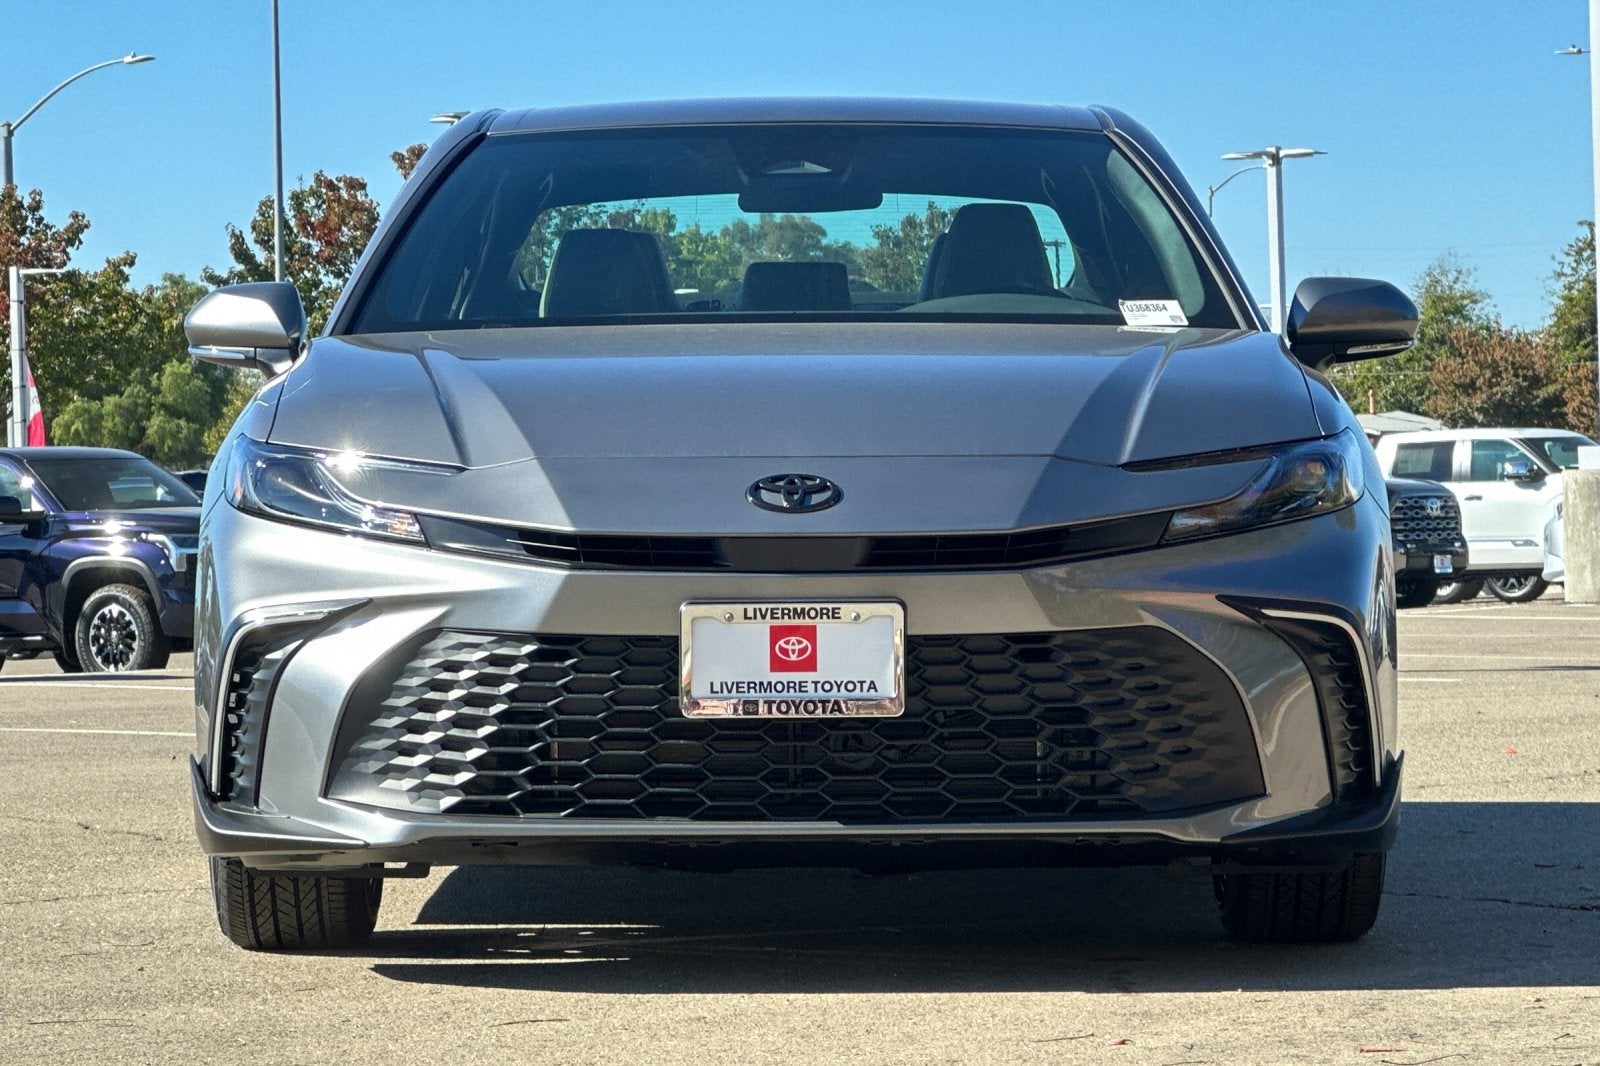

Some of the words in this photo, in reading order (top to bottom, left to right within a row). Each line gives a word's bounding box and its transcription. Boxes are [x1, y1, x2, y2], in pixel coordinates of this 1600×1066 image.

[743, 607, 841, 620] LIVERMORE
[710, 681, 808, 694] LIVERMORE
[812, 680, 879, 693] TOYOTA
[764, 699, 843, 715] TOYOTA
